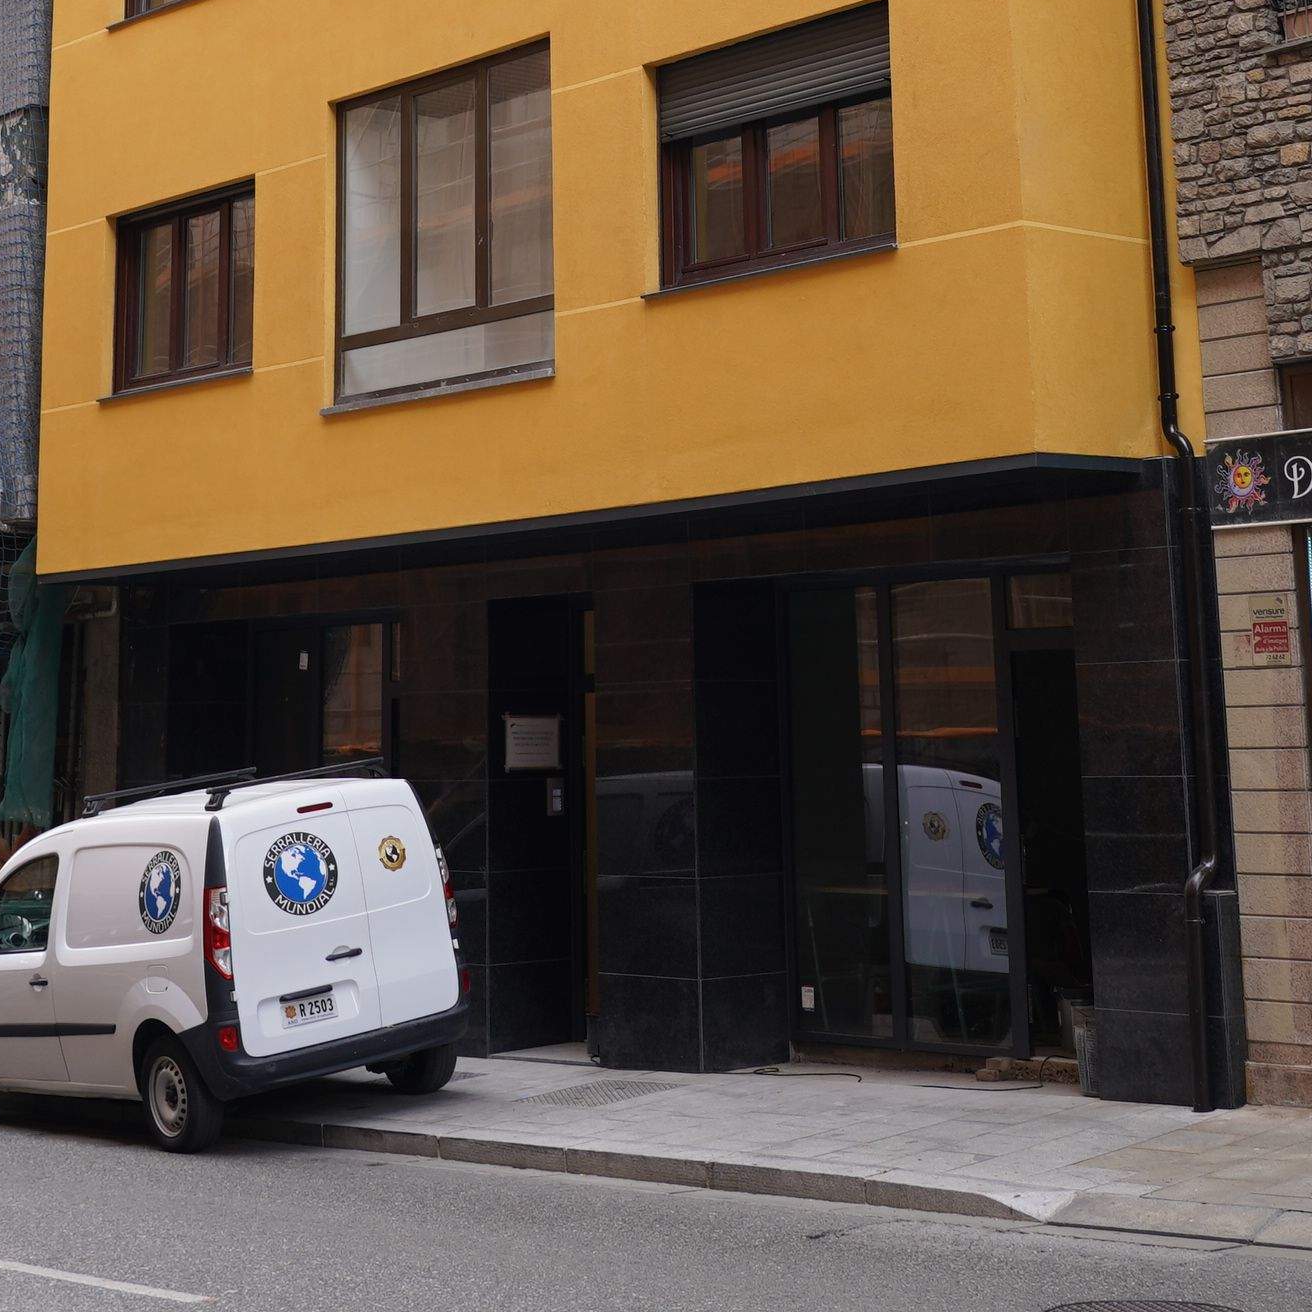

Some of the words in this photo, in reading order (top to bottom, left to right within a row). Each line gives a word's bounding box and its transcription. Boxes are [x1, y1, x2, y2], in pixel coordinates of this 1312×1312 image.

[1254, 624, 1287, 633] Alarma
[264, 832, 331, 870] SERRALLERIA
[274, 888, 335, 915] MUNDIAL
[141, 910, 177, 933] MUNDIAL
[298, 1003, 307, 1018] R
[308, 998, 335, 1016] 2503
